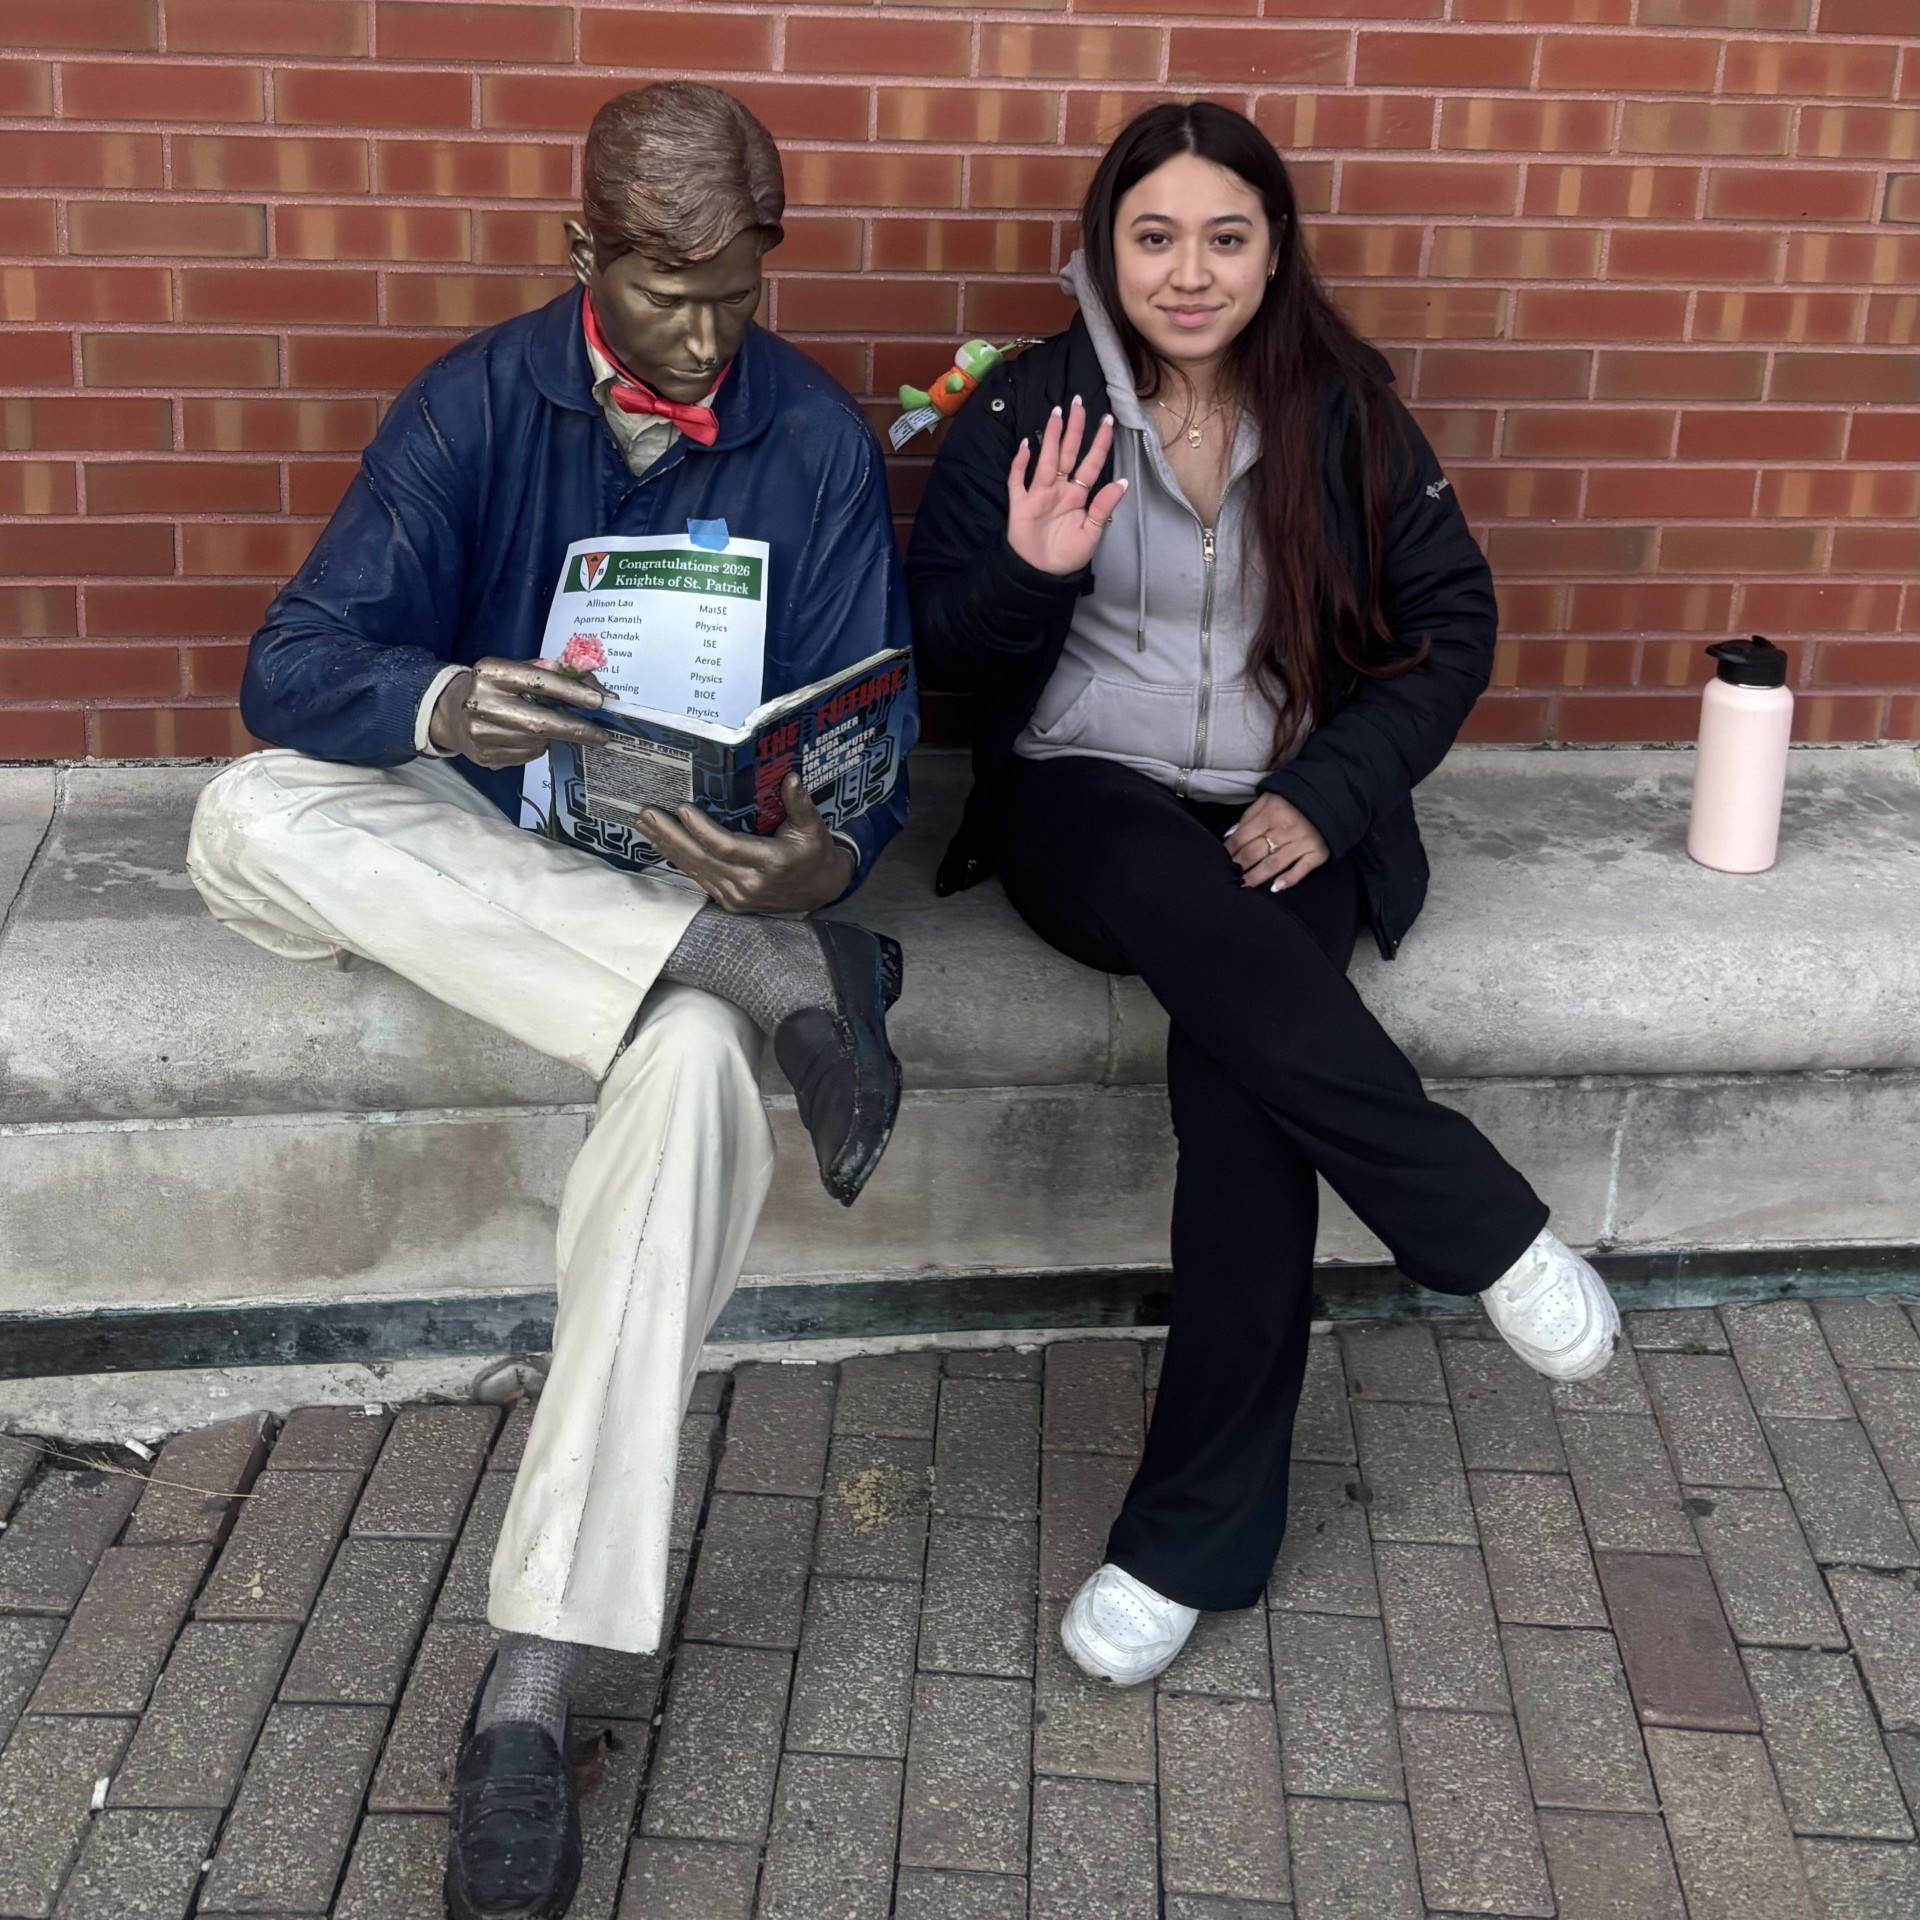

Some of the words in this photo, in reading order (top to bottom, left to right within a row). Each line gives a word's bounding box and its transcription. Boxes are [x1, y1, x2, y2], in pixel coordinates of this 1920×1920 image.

[618, 557, 719, 573] Congratulations
[722, 563, 750, 577] 2026
[615, 574, 664, 587] Knights
[668, 575, 680, 588] of
[683, 577, 701, 590] St.
[706, 579, 749, 595] Patrick
[586, 599, 616, 608] Allison
[618, 599, 634, 608] Lau
[574, 616, 605, 625] Aparna
[607, 615, 642, 624] Kamath
[695, 621, 728, 633] Physics
[600, 631, 640, 641] Chandak
[703, 639, 717, 648] ISE
[607, 648, 633, 658] Sawa
[695, 656, 722, 666] AeroE
[611, 665, 620, 673] Li
[690, 672, 723, 684] Physics
[603, 681, 639, 694] Fanning
[694, 690, 716, 700] BIOE
[687, 706, 719, 718] Physics
[757, 720, 799, 760] THE
[816, 665, 904, 730] FUTURE
[803, 743, 809, 754] A
[815, 716, 859, 747] BROADER
[802, 737, 839, 764] AGENDA
[802, 758, 820, 775] FOR
[826, 727, 876, 761] COMPUTER
[802, 757, 840, 785] SCIENCE
[845, 743, 865, 760] AND
